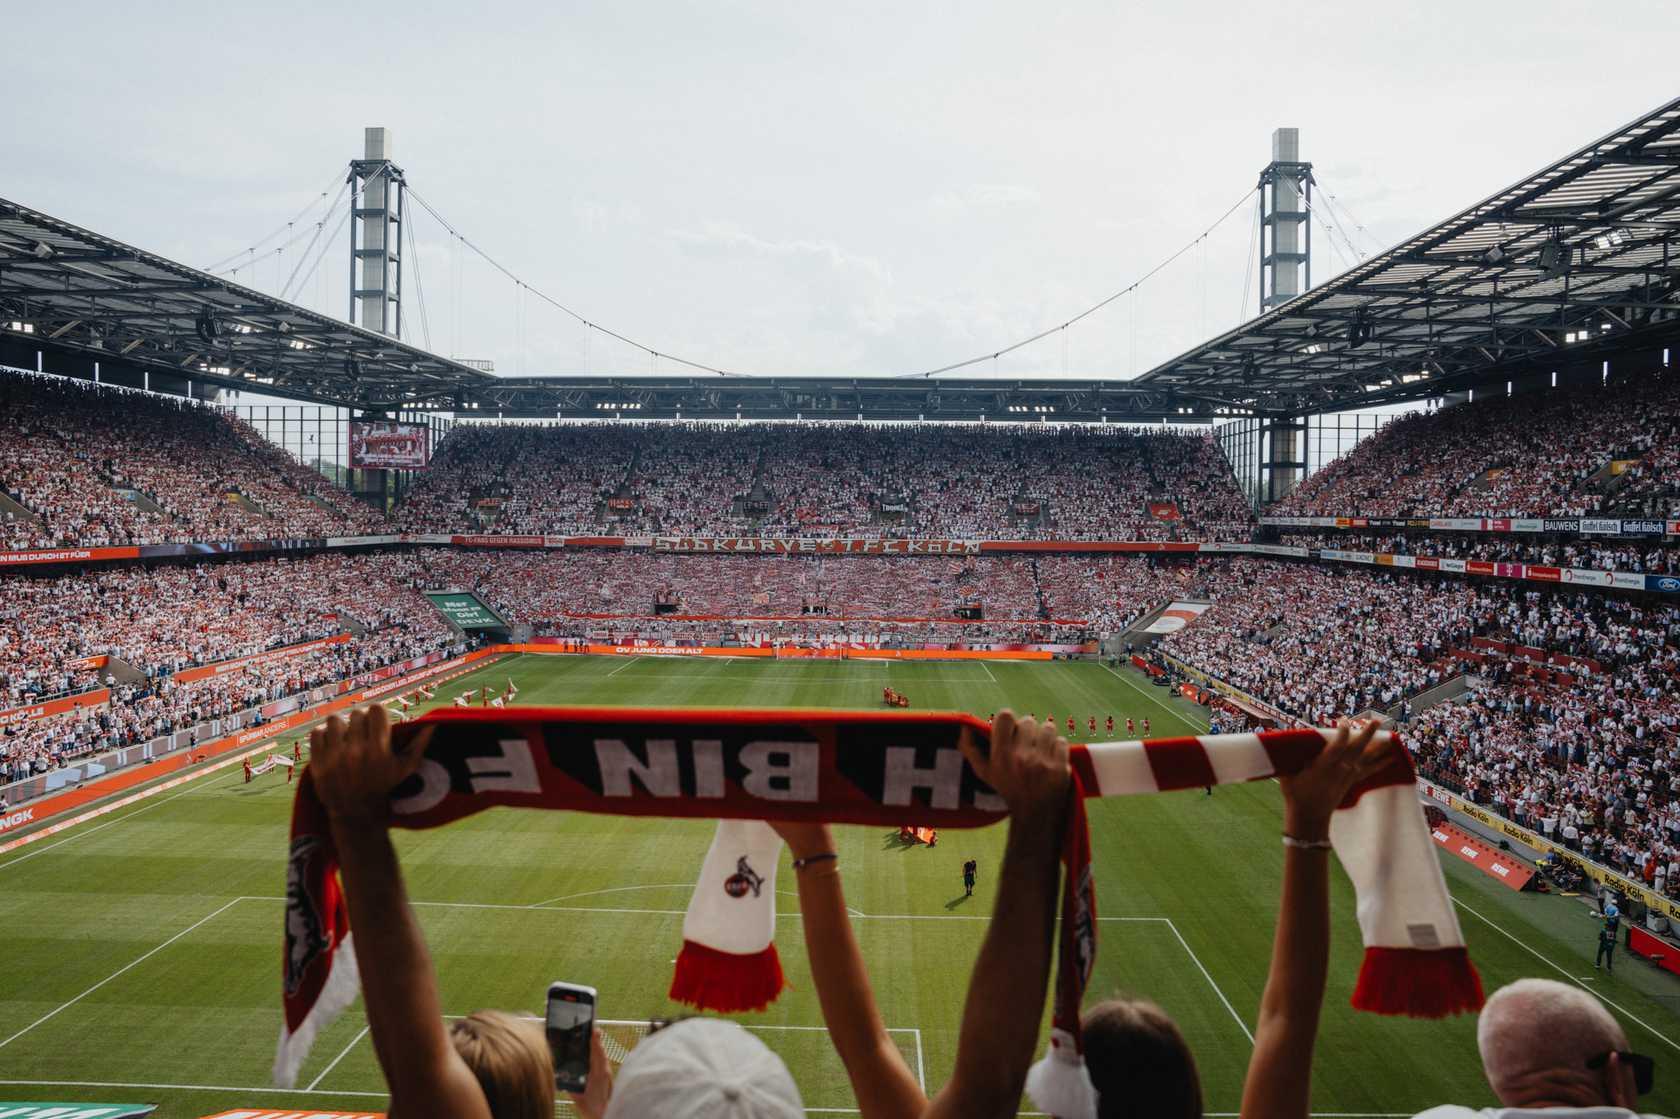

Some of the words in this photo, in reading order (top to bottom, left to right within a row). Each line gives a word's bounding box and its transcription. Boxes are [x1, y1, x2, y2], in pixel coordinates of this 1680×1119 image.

[1544, 521, 1579, 531] BAUWENS
[685, 647, 704, 655] ALT
[593, 739, 820, 802] BIN
[1604, 873, 1626, 893] Radio
[1625, 884, 1645, 902] Köln
